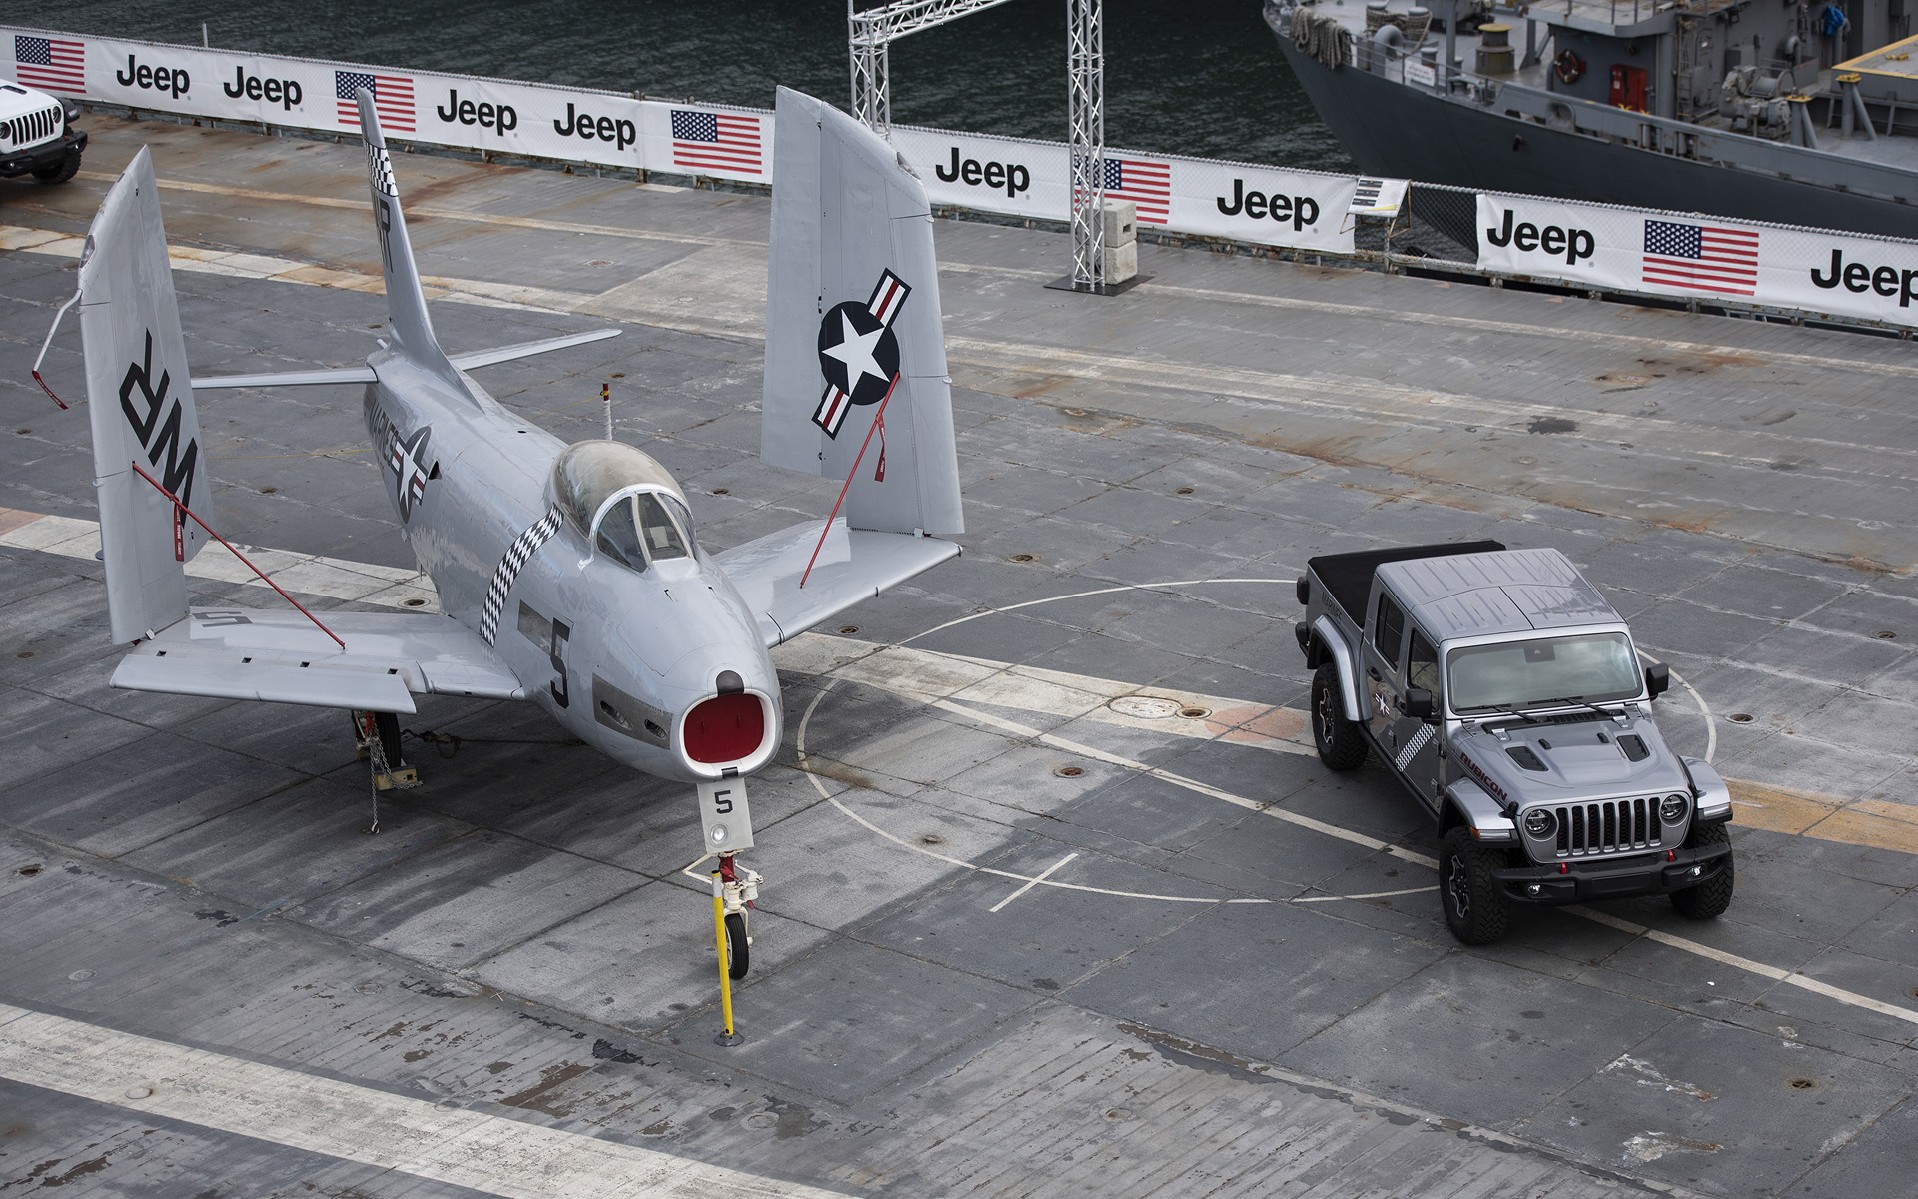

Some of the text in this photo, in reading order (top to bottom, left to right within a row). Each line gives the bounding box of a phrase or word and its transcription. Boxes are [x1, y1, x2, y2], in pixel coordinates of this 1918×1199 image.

[116, 54, 191, 100] Jeep
[223, 65, 303, 111] Jeep
[437, 88, 518, 137] Jeep
[553, 102, 636, 151] Jeep
[935, 146, 1030, 198] Jeep
[1216, 178, 1320, 232] Jeep
[1486, 209, 1595, 266] Jeep
[549, 617, 571, 709] 5
[1459, 751, 1508, 801] RUBICON
[714, 789, 733, 814] 5
